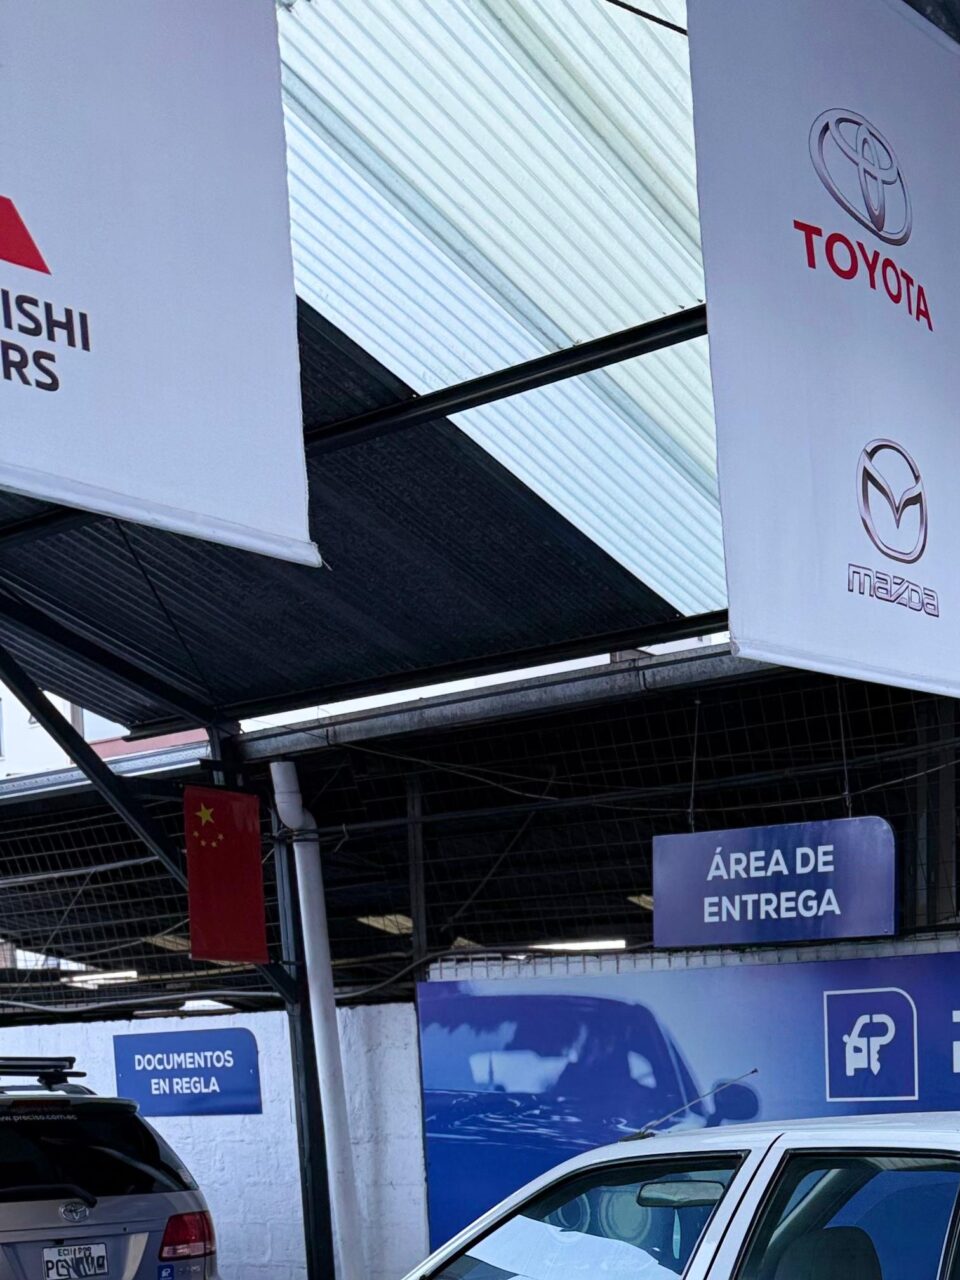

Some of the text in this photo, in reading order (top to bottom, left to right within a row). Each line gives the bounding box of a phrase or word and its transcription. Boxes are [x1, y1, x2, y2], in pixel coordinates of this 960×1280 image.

[794, 220, 933, 331] TOYOTA
[706, 845, 835, 881] ÁREA DE
[703, 889, 842, 923] ENTREGA
[134, 1050, 234, 1071] DOCUMENTOS
[150, 1077, 220, 1095] EN REGLA
